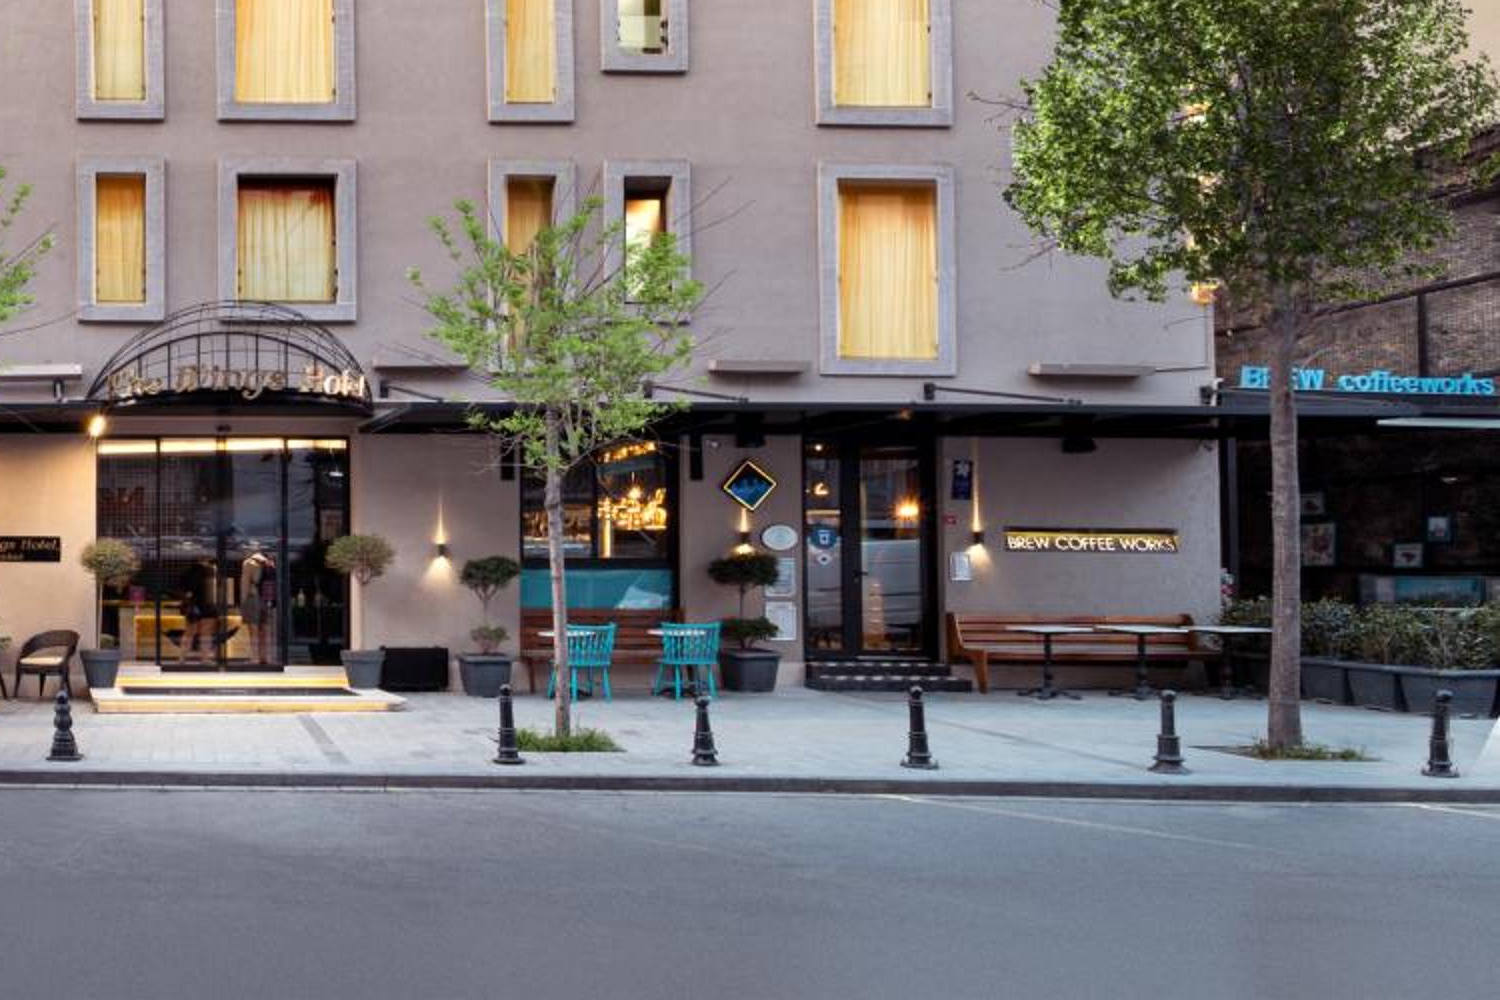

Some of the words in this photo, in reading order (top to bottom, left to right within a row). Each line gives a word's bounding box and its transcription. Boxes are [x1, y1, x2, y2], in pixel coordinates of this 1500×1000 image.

[1007, 535, 1049, 549] BREW
[1055, 536, 1116, 551] COFFEE
[1119, 538, 1176, 551] WORKS
